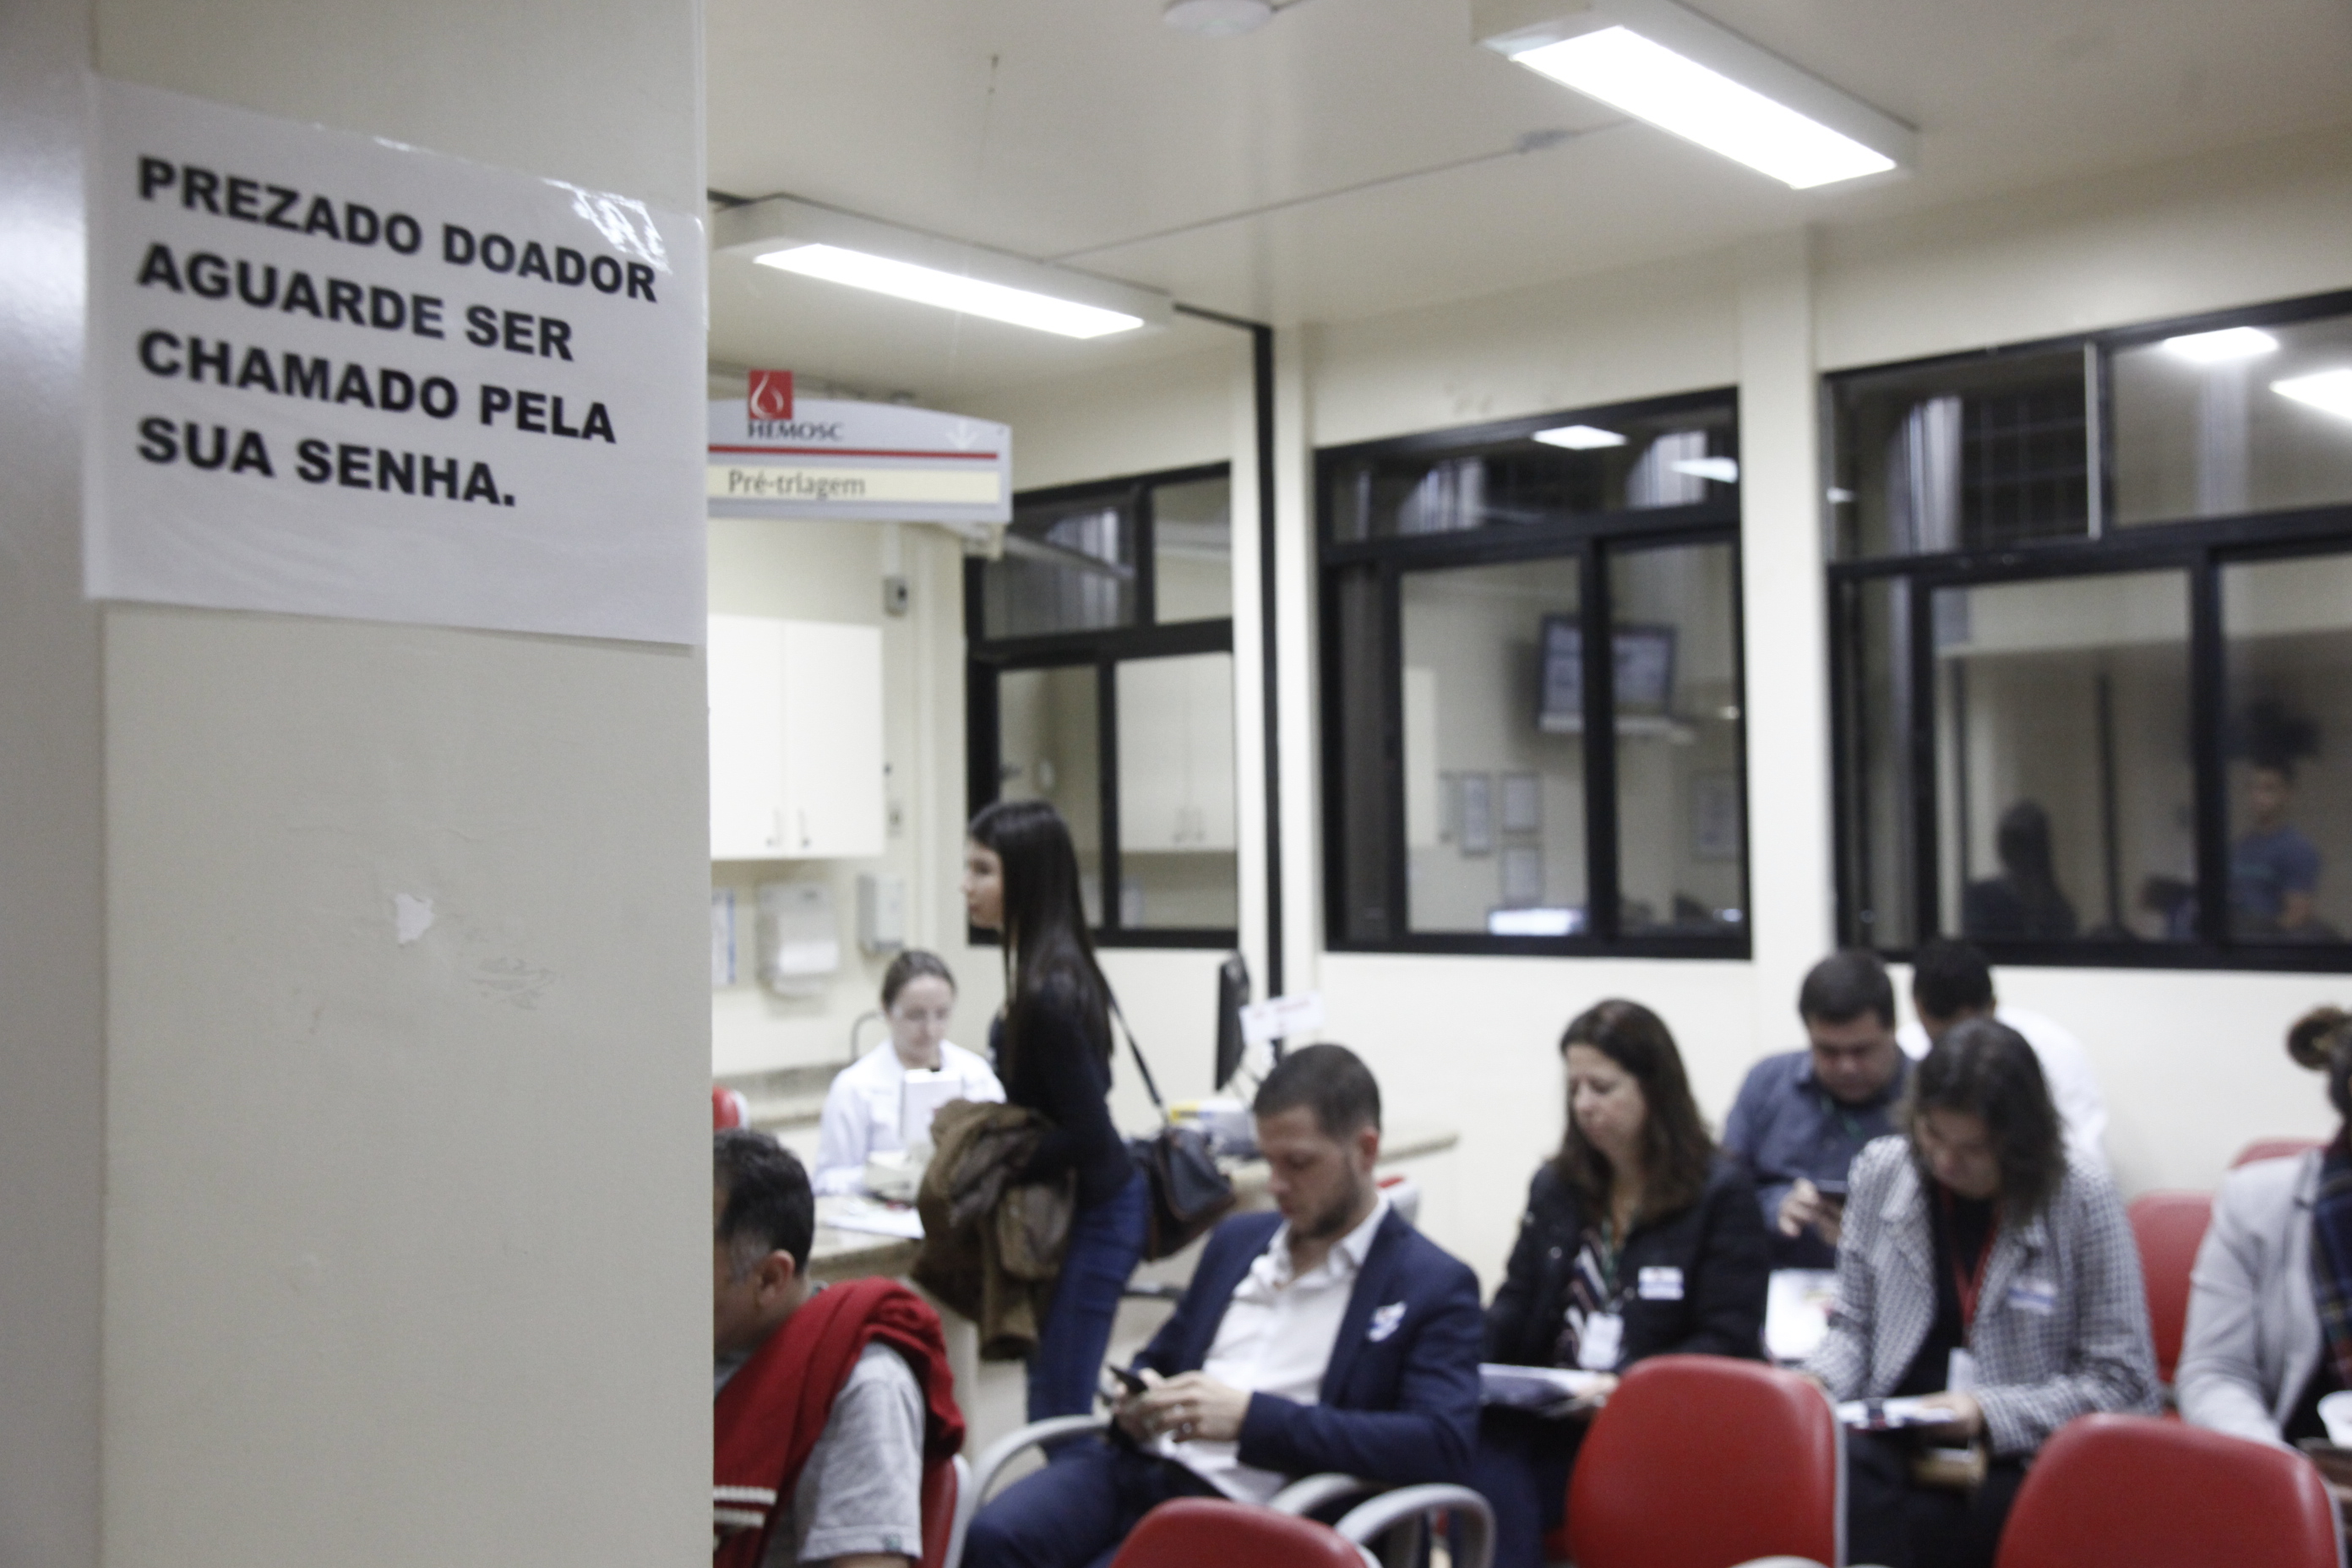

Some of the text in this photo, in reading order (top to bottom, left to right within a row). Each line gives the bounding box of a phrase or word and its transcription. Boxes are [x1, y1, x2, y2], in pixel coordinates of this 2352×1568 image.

[138, 155, 657, 303] PREZADO DOADOR
[135, 242, 574, 362] AGUARDE SER
[138, 329, 617, 444] CHAMADO PELA
[749, 421, 844, 440] HEMOSC
[138, 416, 516, 507] SUA SENHA.
[729, 470, 866, 498] Pré-triagem
